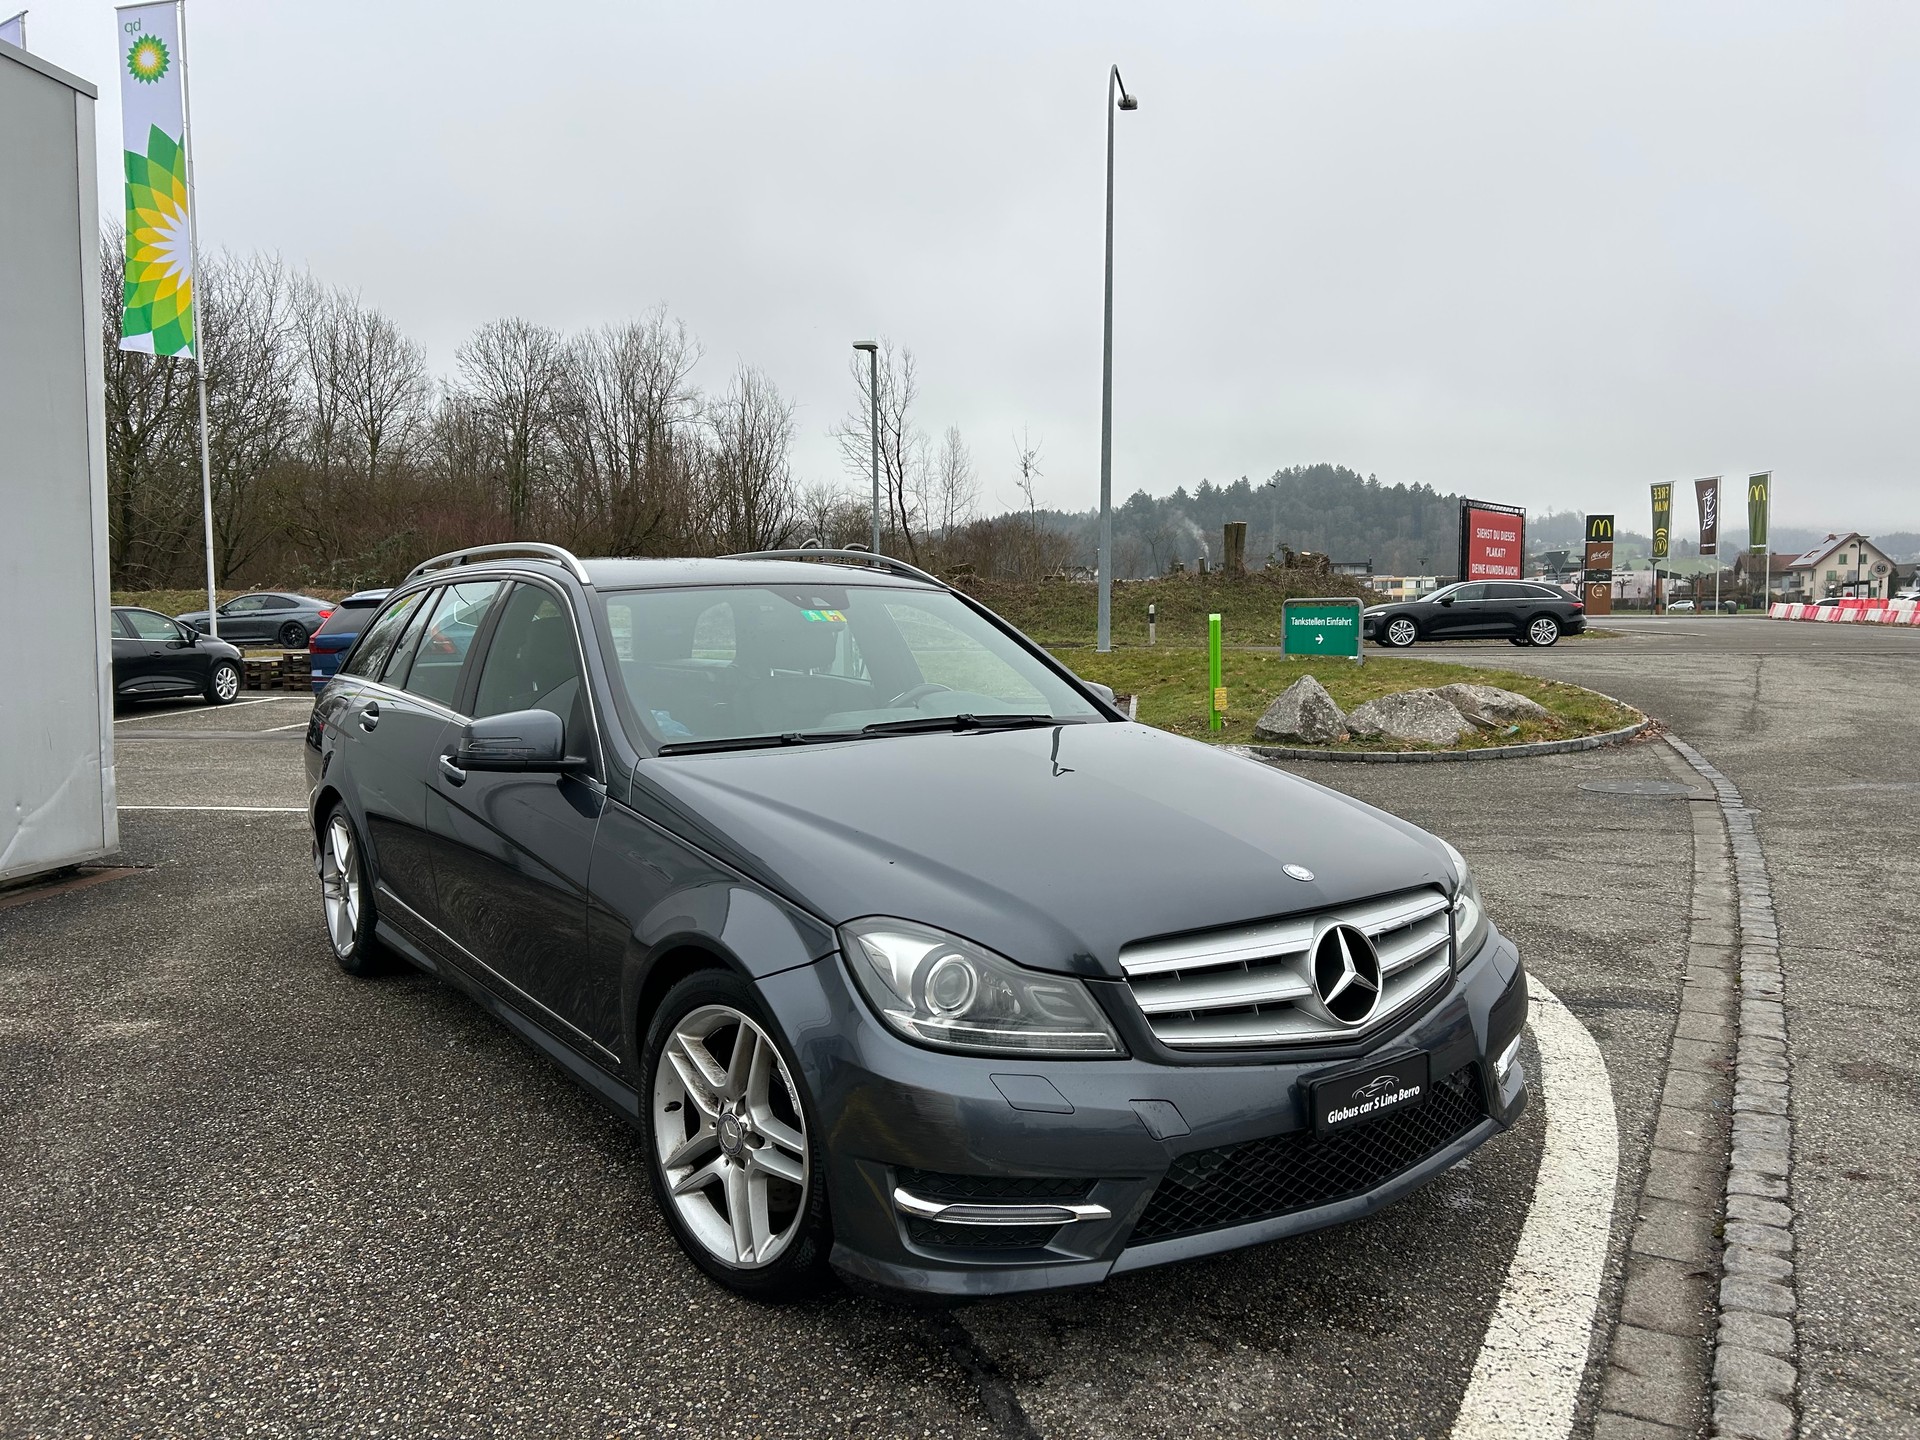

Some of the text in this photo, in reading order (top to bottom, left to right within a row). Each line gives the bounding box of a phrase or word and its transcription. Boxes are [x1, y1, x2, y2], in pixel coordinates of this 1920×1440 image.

[1476, 528, 1515, 541] SIEHST DU DIESES
[1486, 547, 1506, 557] PLAKAT?
[1472, 564, 1485, 574] DEINE
[1486, 565, 1504, 575] KUNDEN
[1291, 617, 1352, 625] Tankstellen Einfahrt
[1328, 1086, 1420, 1123] Globus car S Line Berro
